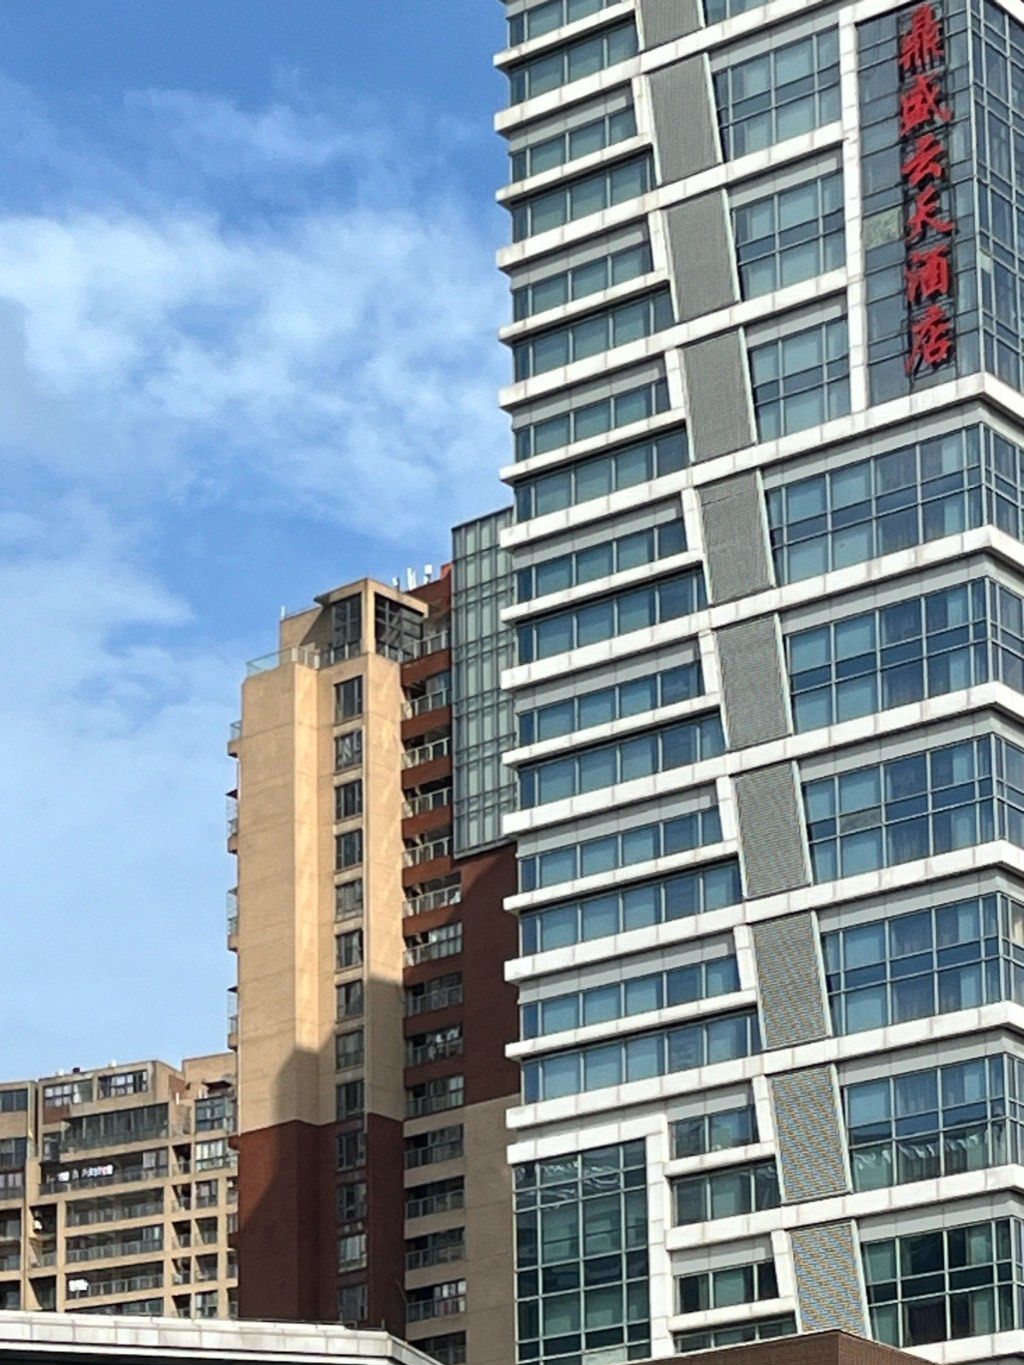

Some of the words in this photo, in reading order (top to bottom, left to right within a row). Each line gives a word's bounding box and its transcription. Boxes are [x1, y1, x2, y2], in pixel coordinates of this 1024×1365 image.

[900, 3, 955, 375] 鼎盛云天酒店
